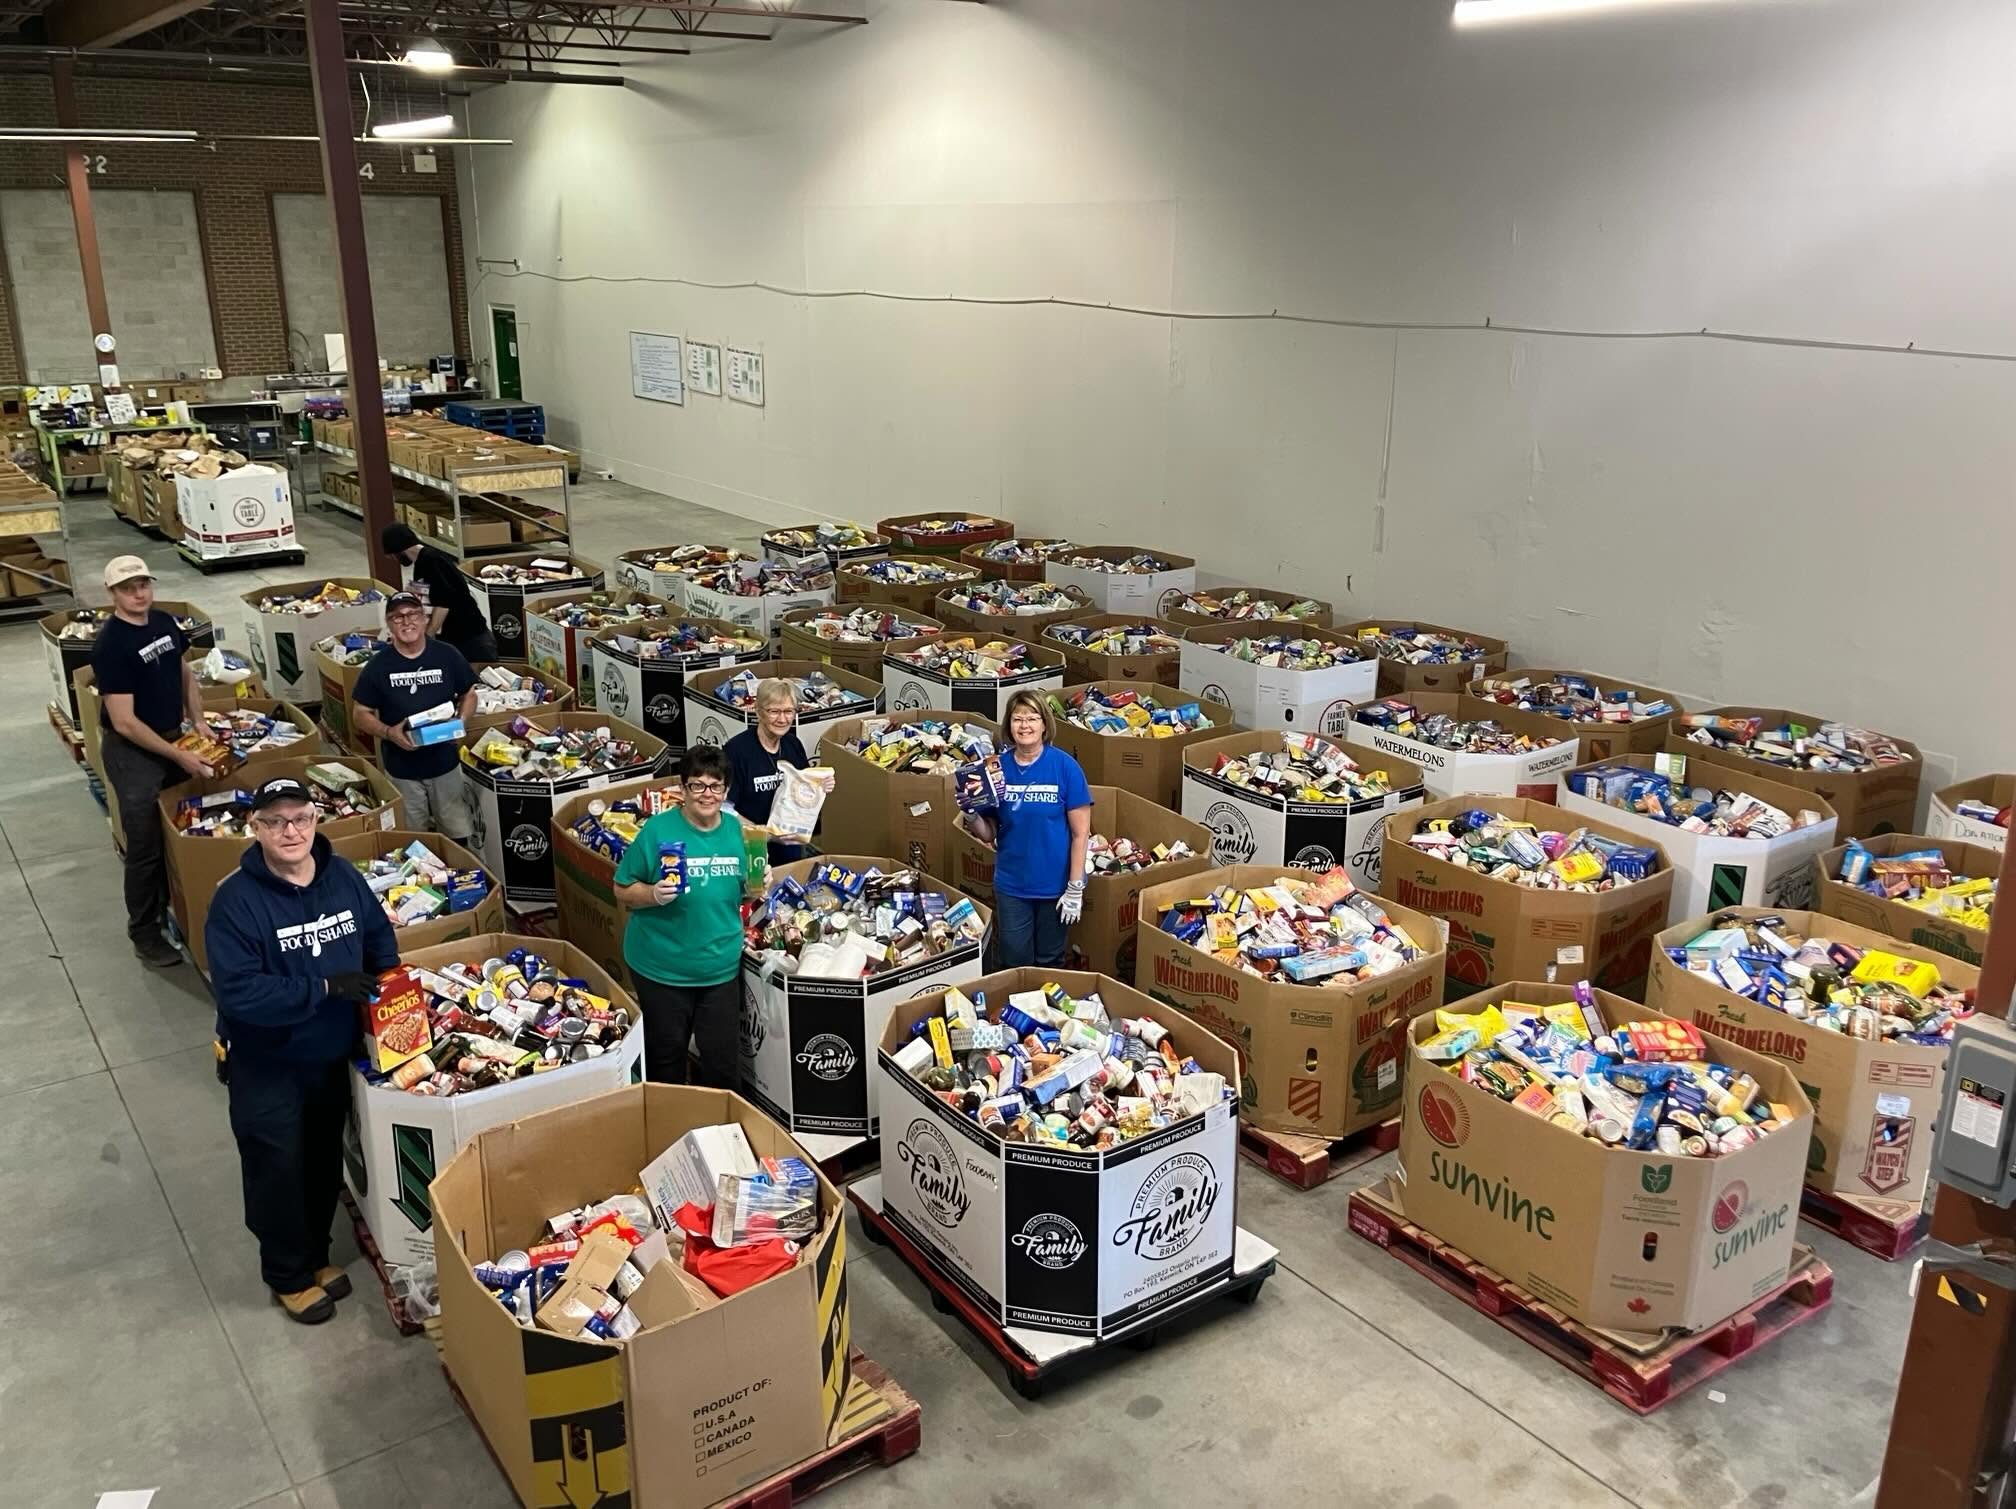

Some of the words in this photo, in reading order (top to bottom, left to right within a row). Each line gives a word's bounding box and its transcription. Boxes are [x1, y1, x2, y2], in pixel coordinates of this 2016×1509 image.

[359, 163, 375, 179] 4
[390, 677, 414, 688] FOOD
[416, 673, 443, 685] SHARE
[1327, 719, 1346, 734] TABL
[1373, 735, 1445, 768] WATERMELONS
[1527, 751, 1573, 773] WATERMELONS
[1023, 791, 1058, 803] SHARE
[1291, 806, 1317, 814] PREMIUM
[505, 833, 550, 853] Family
[1397, 878, 1484, 918] WATERMELONS
[318, 919, 357, 944] SHARE
[1170, 949, 1193, 968] Fresh
[898, 969, 926, 984] PREMIUM
[925, 960, 952, 975] PRODUCE
[1155, 956, 1239, 1001] WATERMELONS
[793, 984, 826, 994] PREMIUM
[826, 986, 860, 995] PRODUCE
[377, 993, 420, 1022] Cheerios
[1718, 1003, 1746, 1024] Fresh
[1694, 1007, 1807, 1061] WATERMELONS
[795, 1049, 859, 1074] Family
[798, 1117, 831, 1128] PREMIUM
[832, 1119, 864, 1130] PRODUCE
[909, 1121, 929, 1144] PREMIUM
[929, 1126, 957, 1168] PRODUCE
[1139, 1136, 1171, 1155] PREMIUM
[1171, 1123, 1202, 1142] PRODUCE
[1011, 1151, 1051, 1165] PREMIUM
[1051, 1157, 1093, 1170] PRODUCE
[1875, 1151, 1900, 1168] WATCH
[897, 1140, 972, 1223] Family
[1135, 1164, 1168, 1210] PREMIUM
[1170, 1154, 1207, 1172] PRODUCE
[1876, 1167, 1894, 1181] STEP
[1430, 1150, 1556, 1241] sunvine
[1025, 1215, 1048, 1233] PREMIUM
[1049, 1215, 1076, 1233] PRODUCE
[1112, 1175, 1223, 1256] Family
[1011, 1233, 1089, 1262] Family
[1159, 1236, 1188, 1257] BRAND
[1711, 1203, 1789, 1270] sunvine
[1123, 1289, 1134, 1300] PO
[1133, 1284, 1145, 1296] Box
[1184, 1260, 1195, 1272] ON
[1136, 1291, 1169, 1311] PREMIUM
[1168, 1276, 1199, 1297] PRODUCE
[1011, 1309, 1050, 1324] PREMIUM
[1051, 1315, 1092, 1328] PRODUCE
[693, 1386, 751, 1420] PRODUCT
[752, 1378, 772, 1393] OF:
[705, 1409, 737, 1430] U.S.A
[706, 1414, 756, 1444] CANADA
[707, 1431, 753, 1459] MEXICO
